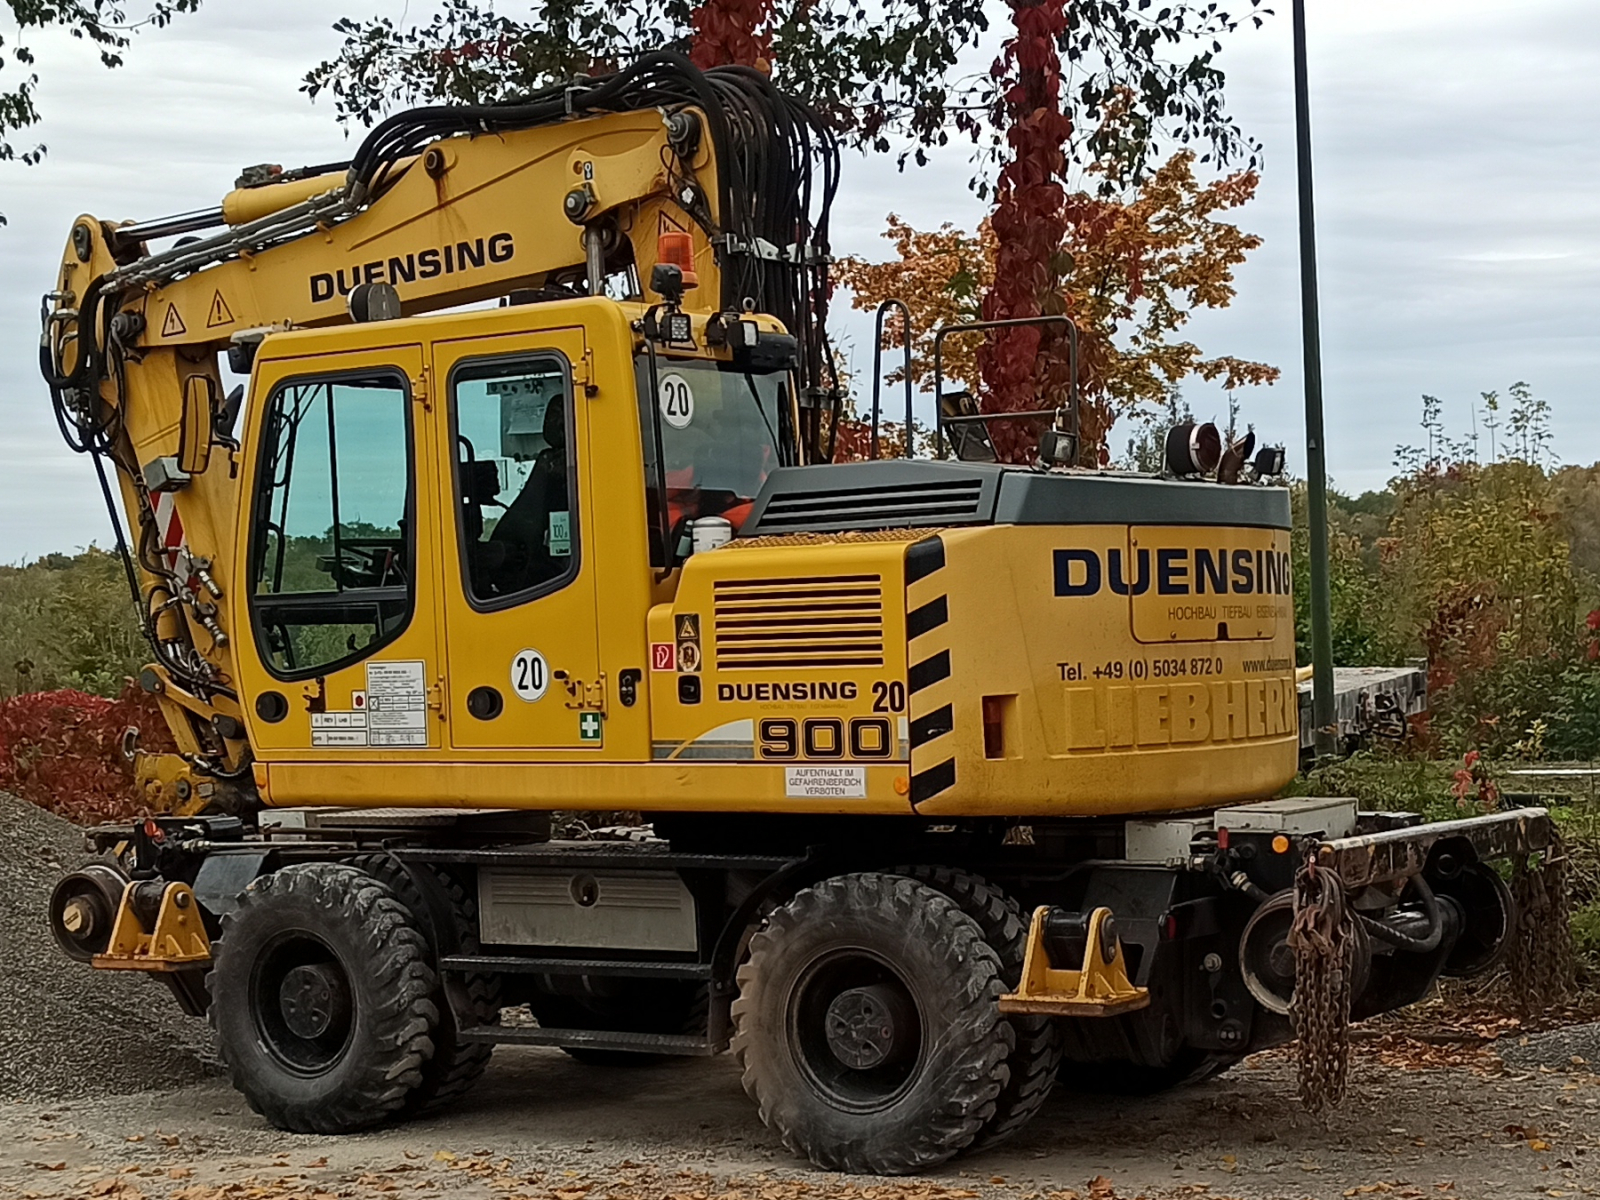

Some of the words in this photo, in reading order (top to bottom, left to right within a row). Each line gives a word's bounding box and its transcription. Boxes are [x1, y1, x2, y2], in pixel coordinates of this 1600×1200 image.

[310, 232, 514, 303] DUENSING
[665, 381, 689, 417] 20
[1053, 548, 1291, 597] DUENSING
[1168, 606, 1217, 620] HOCHBAU
[1222, 605, 1252, 619] TIEFBAU
[516, 657, 543, 690] 20
[1057, 662, 1087, 681] Tel.
[1092, 661, 1124, 679] +49
[1129, 660, 1149, 681] (0)
[1153, 659, 1186, 678] 5034
[1191, 658, 1213, 676] 872
[718, 682, 857, 701] DUENSING
[872, 681, 905, 713] 20
[1064, 677, 1297, 752] LIEBHERR
[759, 717, 893, 759] 900
[788, 778, 861, 787] GEFAHRENBEREICH
[795, 769, 843, 777] AUFENTHALT
[804, 787, 846, 795] VERBOTEN
